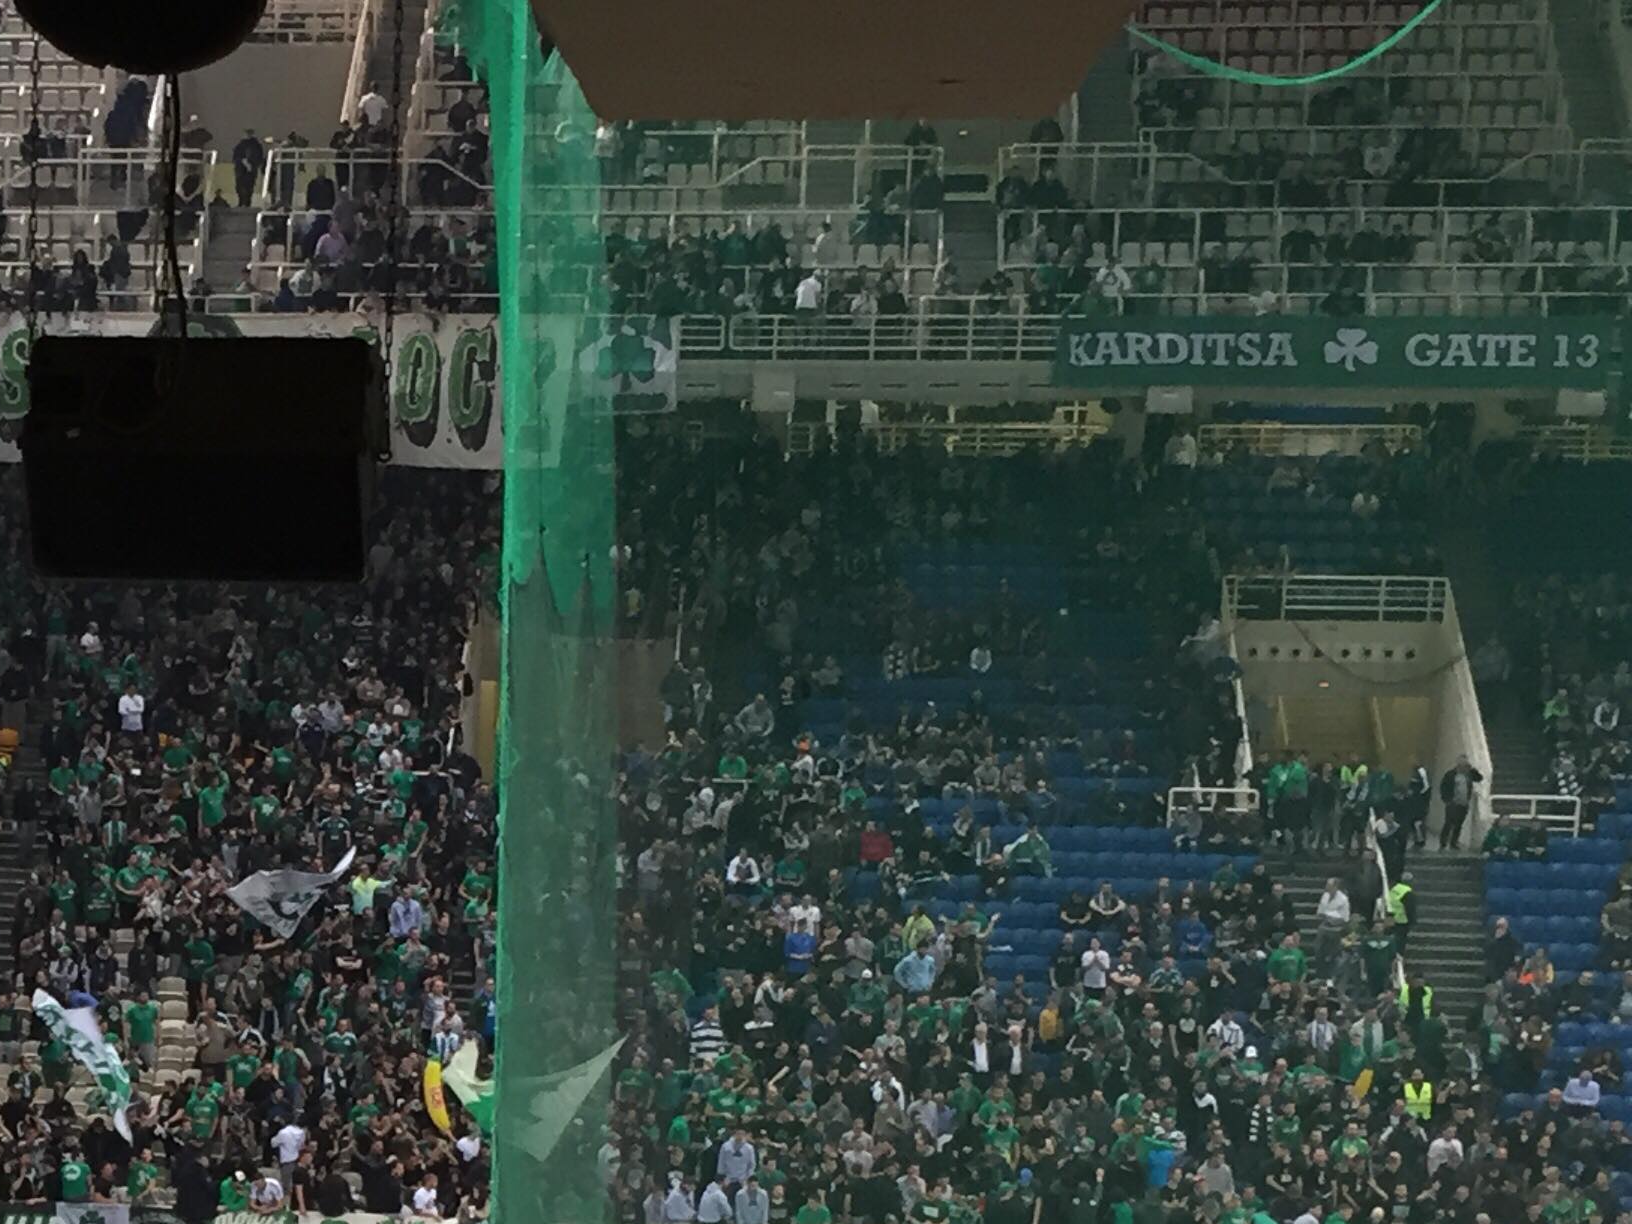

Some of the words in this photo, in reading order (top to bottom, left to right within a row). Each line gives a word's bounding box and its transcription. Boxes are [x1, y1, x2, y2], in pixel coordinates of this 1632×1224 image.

[1069, 330, 1298, 367] KARDITSA
[1405, 332, 1537, 368] GATE
[1552, 333, 1601, 368] 13
